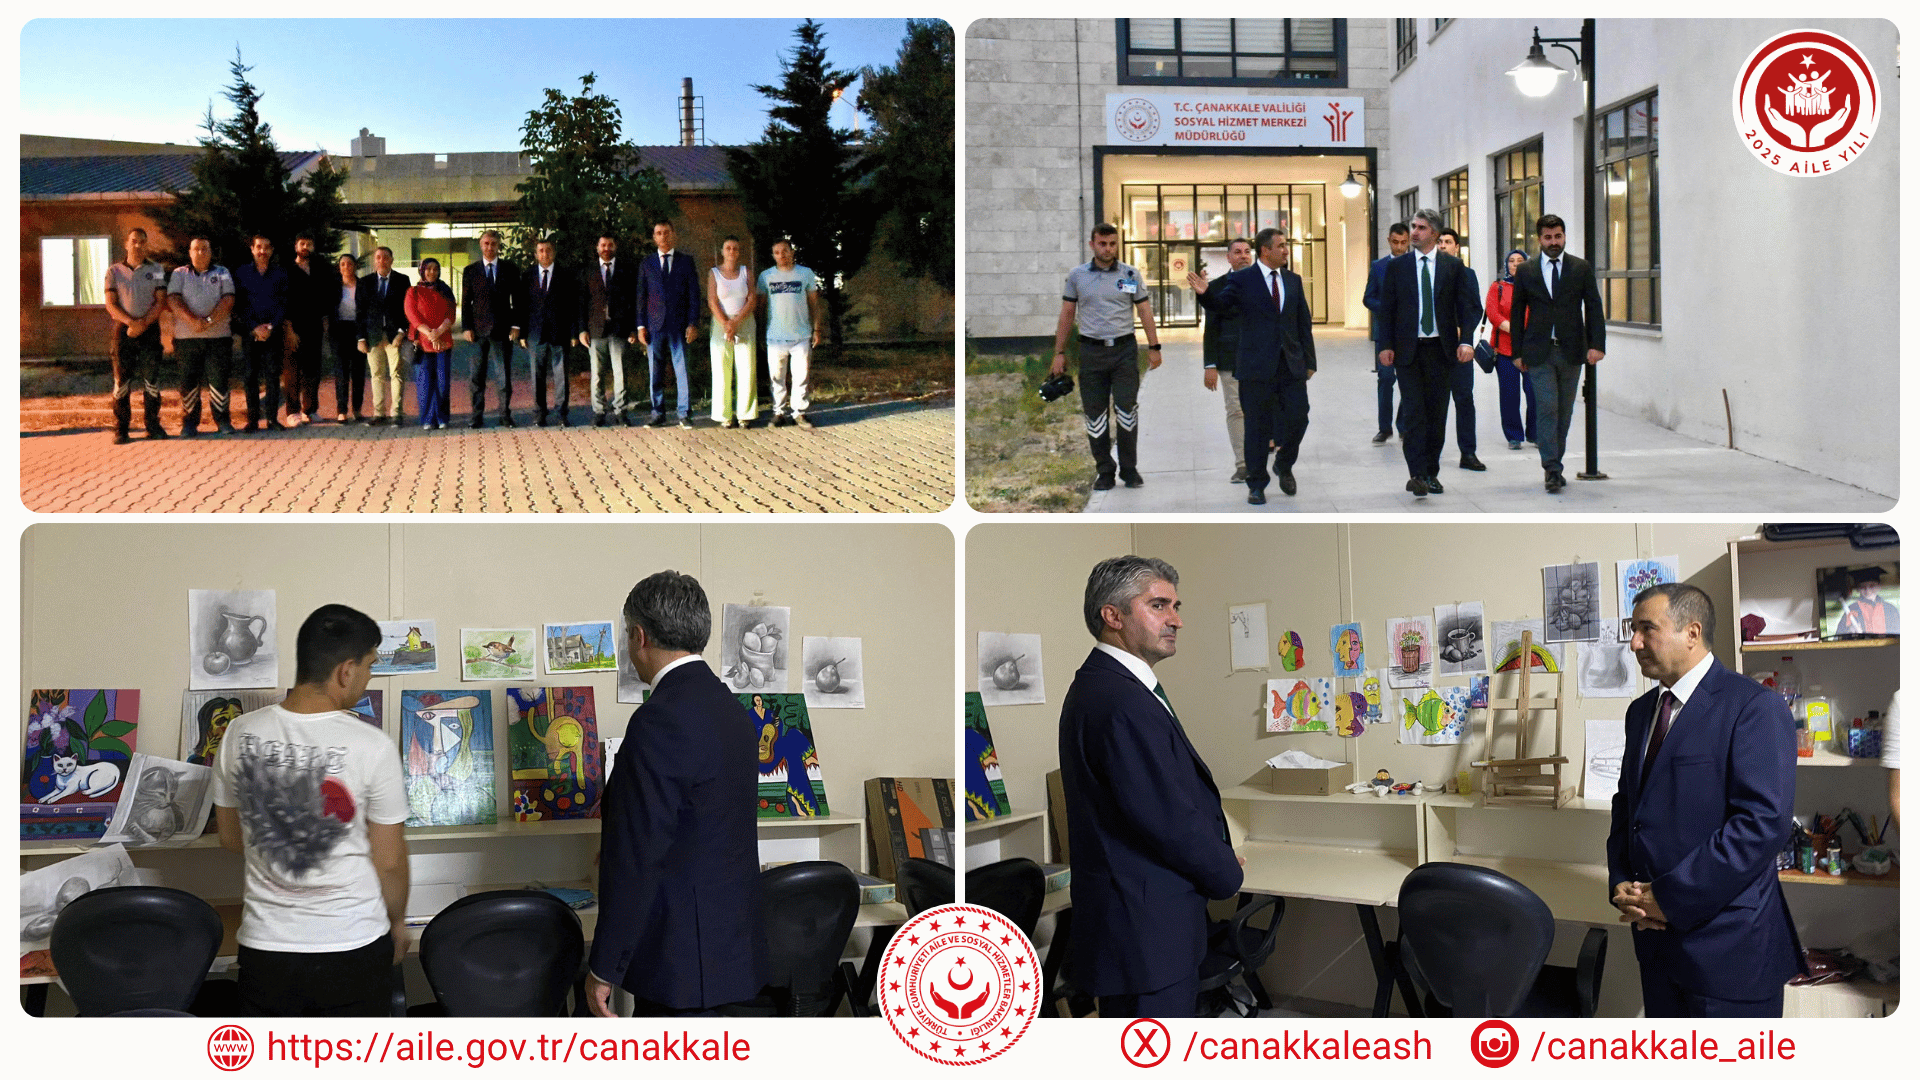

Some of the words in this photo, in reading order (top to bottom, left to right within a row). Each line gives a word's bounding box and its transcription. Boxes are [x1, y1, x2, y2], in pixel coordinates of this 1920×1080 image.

[1174, 103, 1193, 112] T.C.
[1196, 103, 1260, 114] ÇANAKKALE
[1262, 102, 1306, 113] VALİLİĞİ
[1175, 117, 1216, 127] SOSYAL
[1218, 116, 1259, 127] HİZMET
[1261, 116, 1307, 128] MERKEZİ
[1175, 130, 1246, 141] MÜDÜRLÜĞÜ
